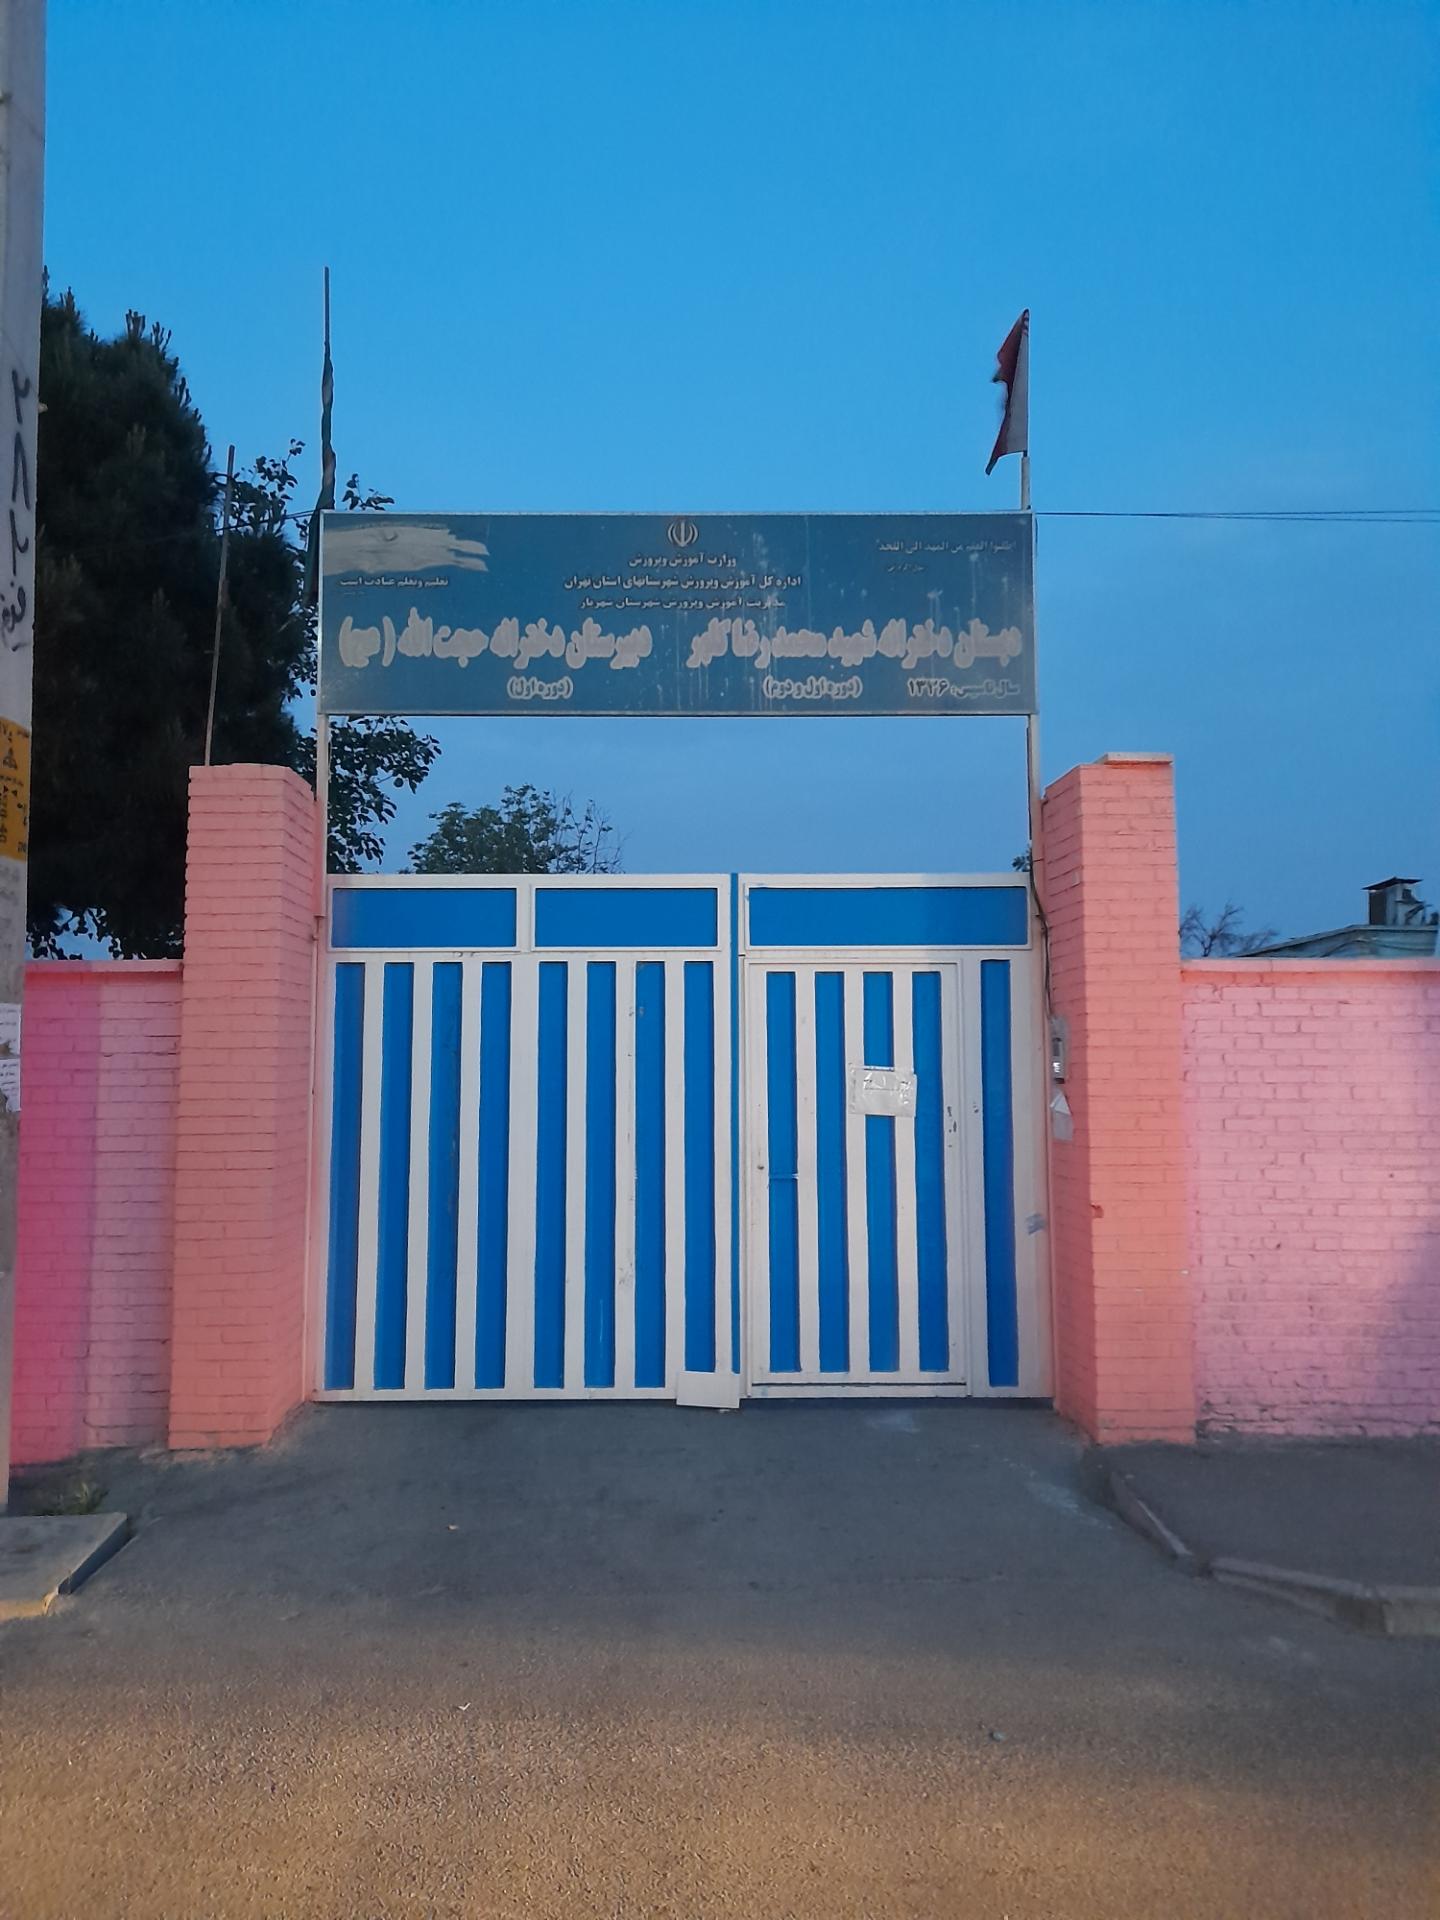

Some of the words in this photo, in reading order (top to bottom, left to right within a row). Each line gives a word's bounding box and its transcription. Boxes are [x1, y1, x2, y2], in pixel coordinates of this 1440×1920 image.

[668, 552, 704, 567] آموزش
[706, 553, 737, 567] وزارت
[339, 576, 363, 586] است
[564, 575, 592, 589] تهران
[592, 575, 621, 589] استان
[720, 574, 756, 589] آموزش
[758, 575, 774, 589] کل
[775, 575, 801, 589] اداره
[580, 596, 613, 608] شهریار
[615, 596, 661, 608] شهرستان
[705, 596, 742, 608] آموزش
[565, 617, 653, 669] دبیرستان
[791, 681, 804, 699] و
[803, 675, 827, 699] اول
